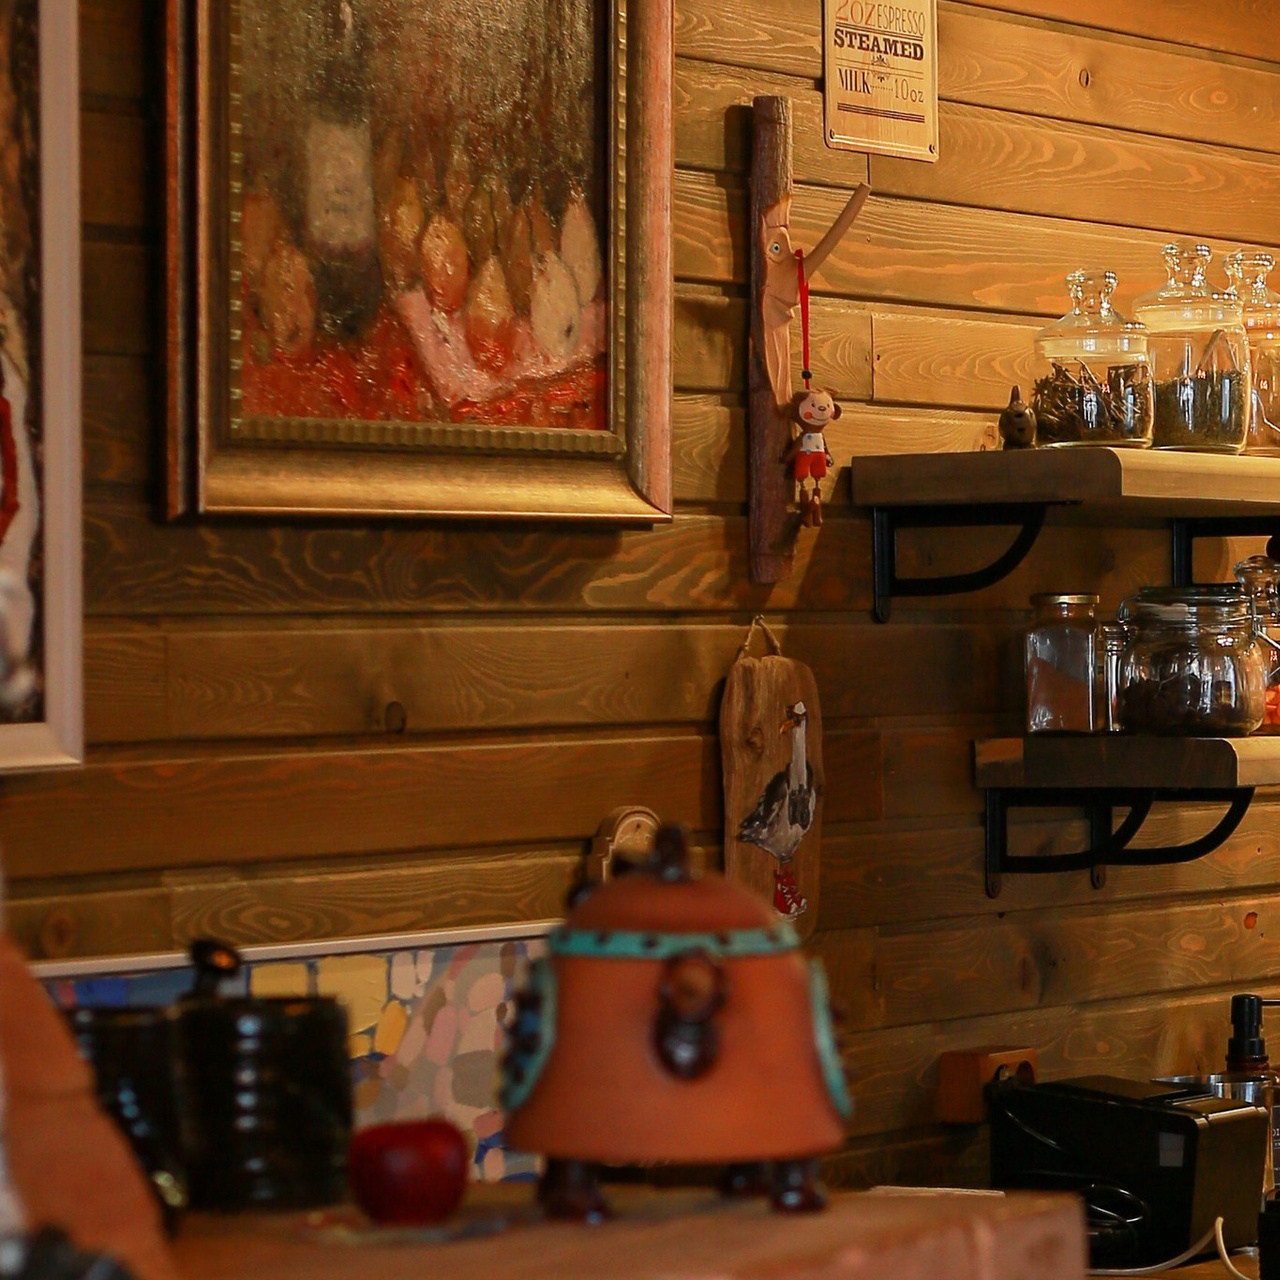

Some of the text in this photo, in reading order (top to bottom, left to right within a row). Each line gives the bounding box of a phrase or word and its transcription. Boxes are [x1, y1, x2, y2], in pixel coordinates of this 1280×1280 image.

[876, 4, 926, 37] ESPRESSO
[834, 28, 925, 61] STEAMED
[837, 67, 872, 95] MILK
